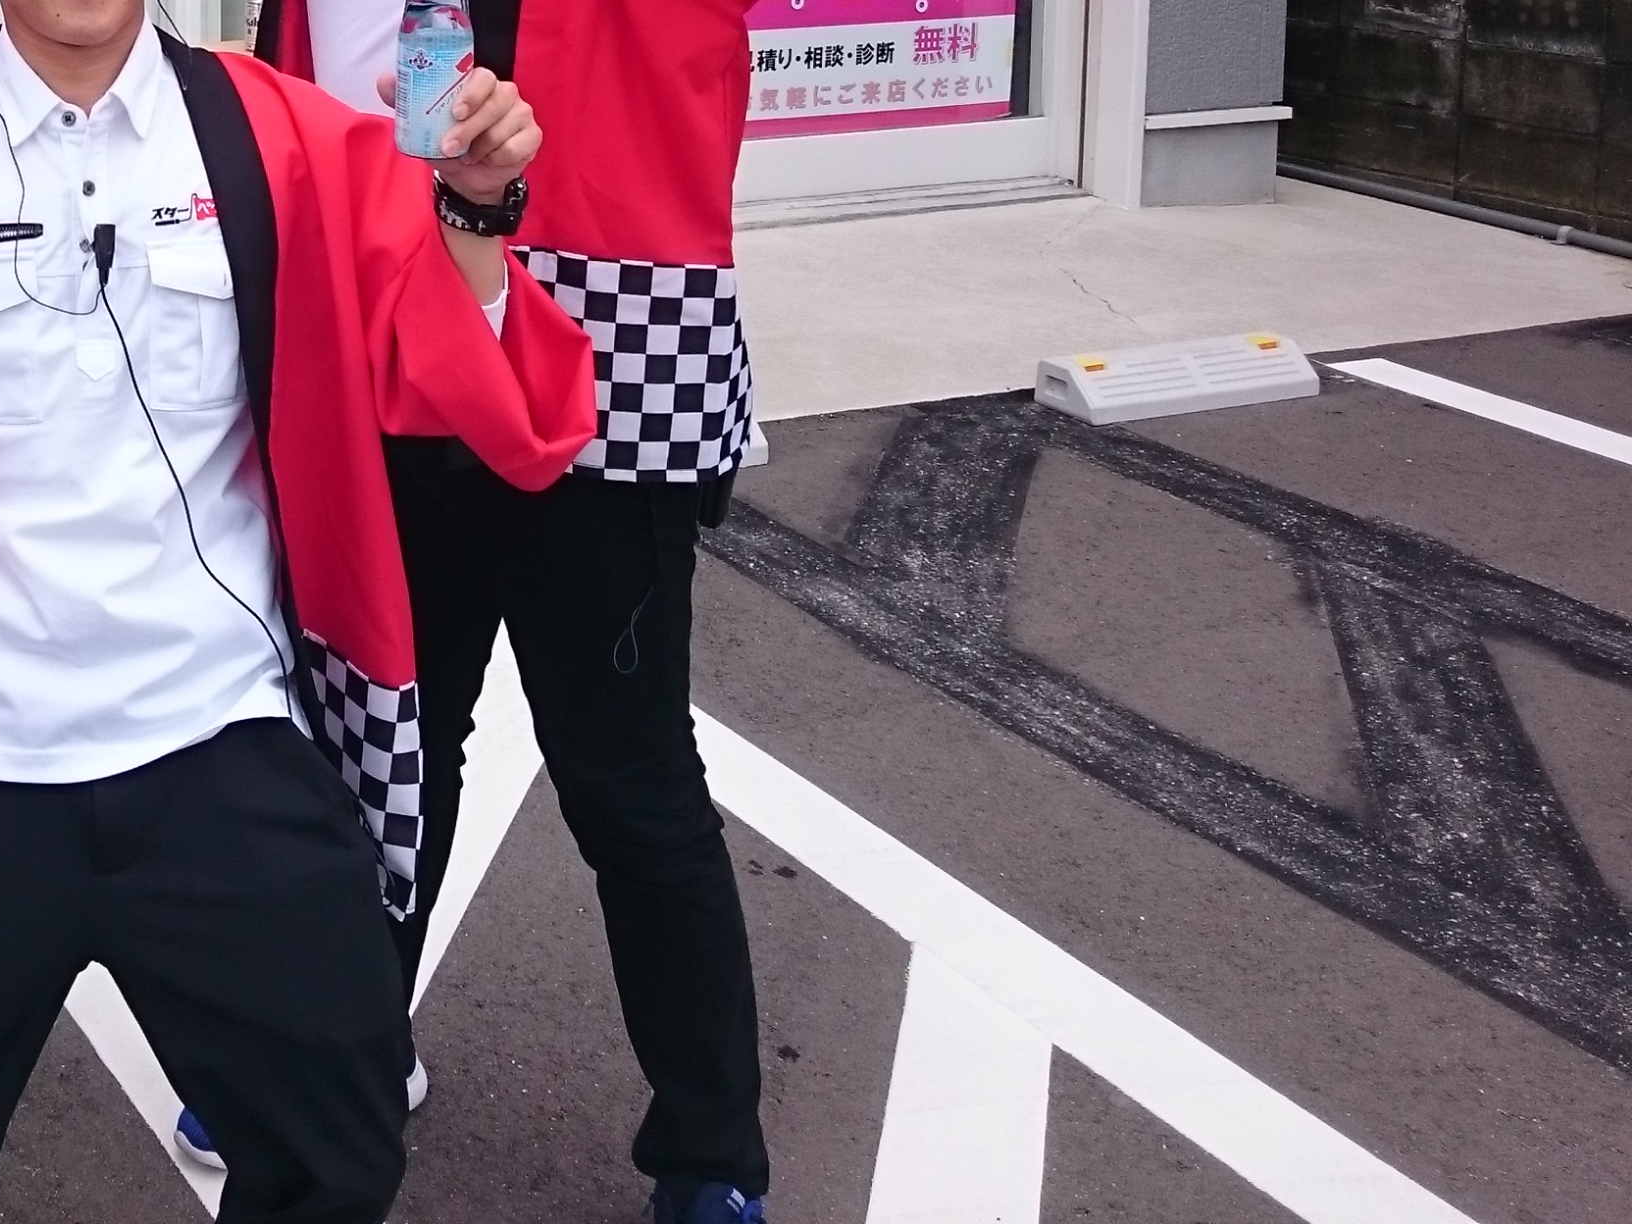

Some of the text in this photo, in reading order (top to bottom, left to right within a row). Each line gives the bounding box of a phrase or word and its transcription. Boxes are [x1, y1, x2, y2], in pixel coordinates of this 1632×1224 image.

[912, 22, 979, 64] 無料
[748, 75, 993, 111] 気軽にご来店ください
[151, 206, 190, 220] スター
